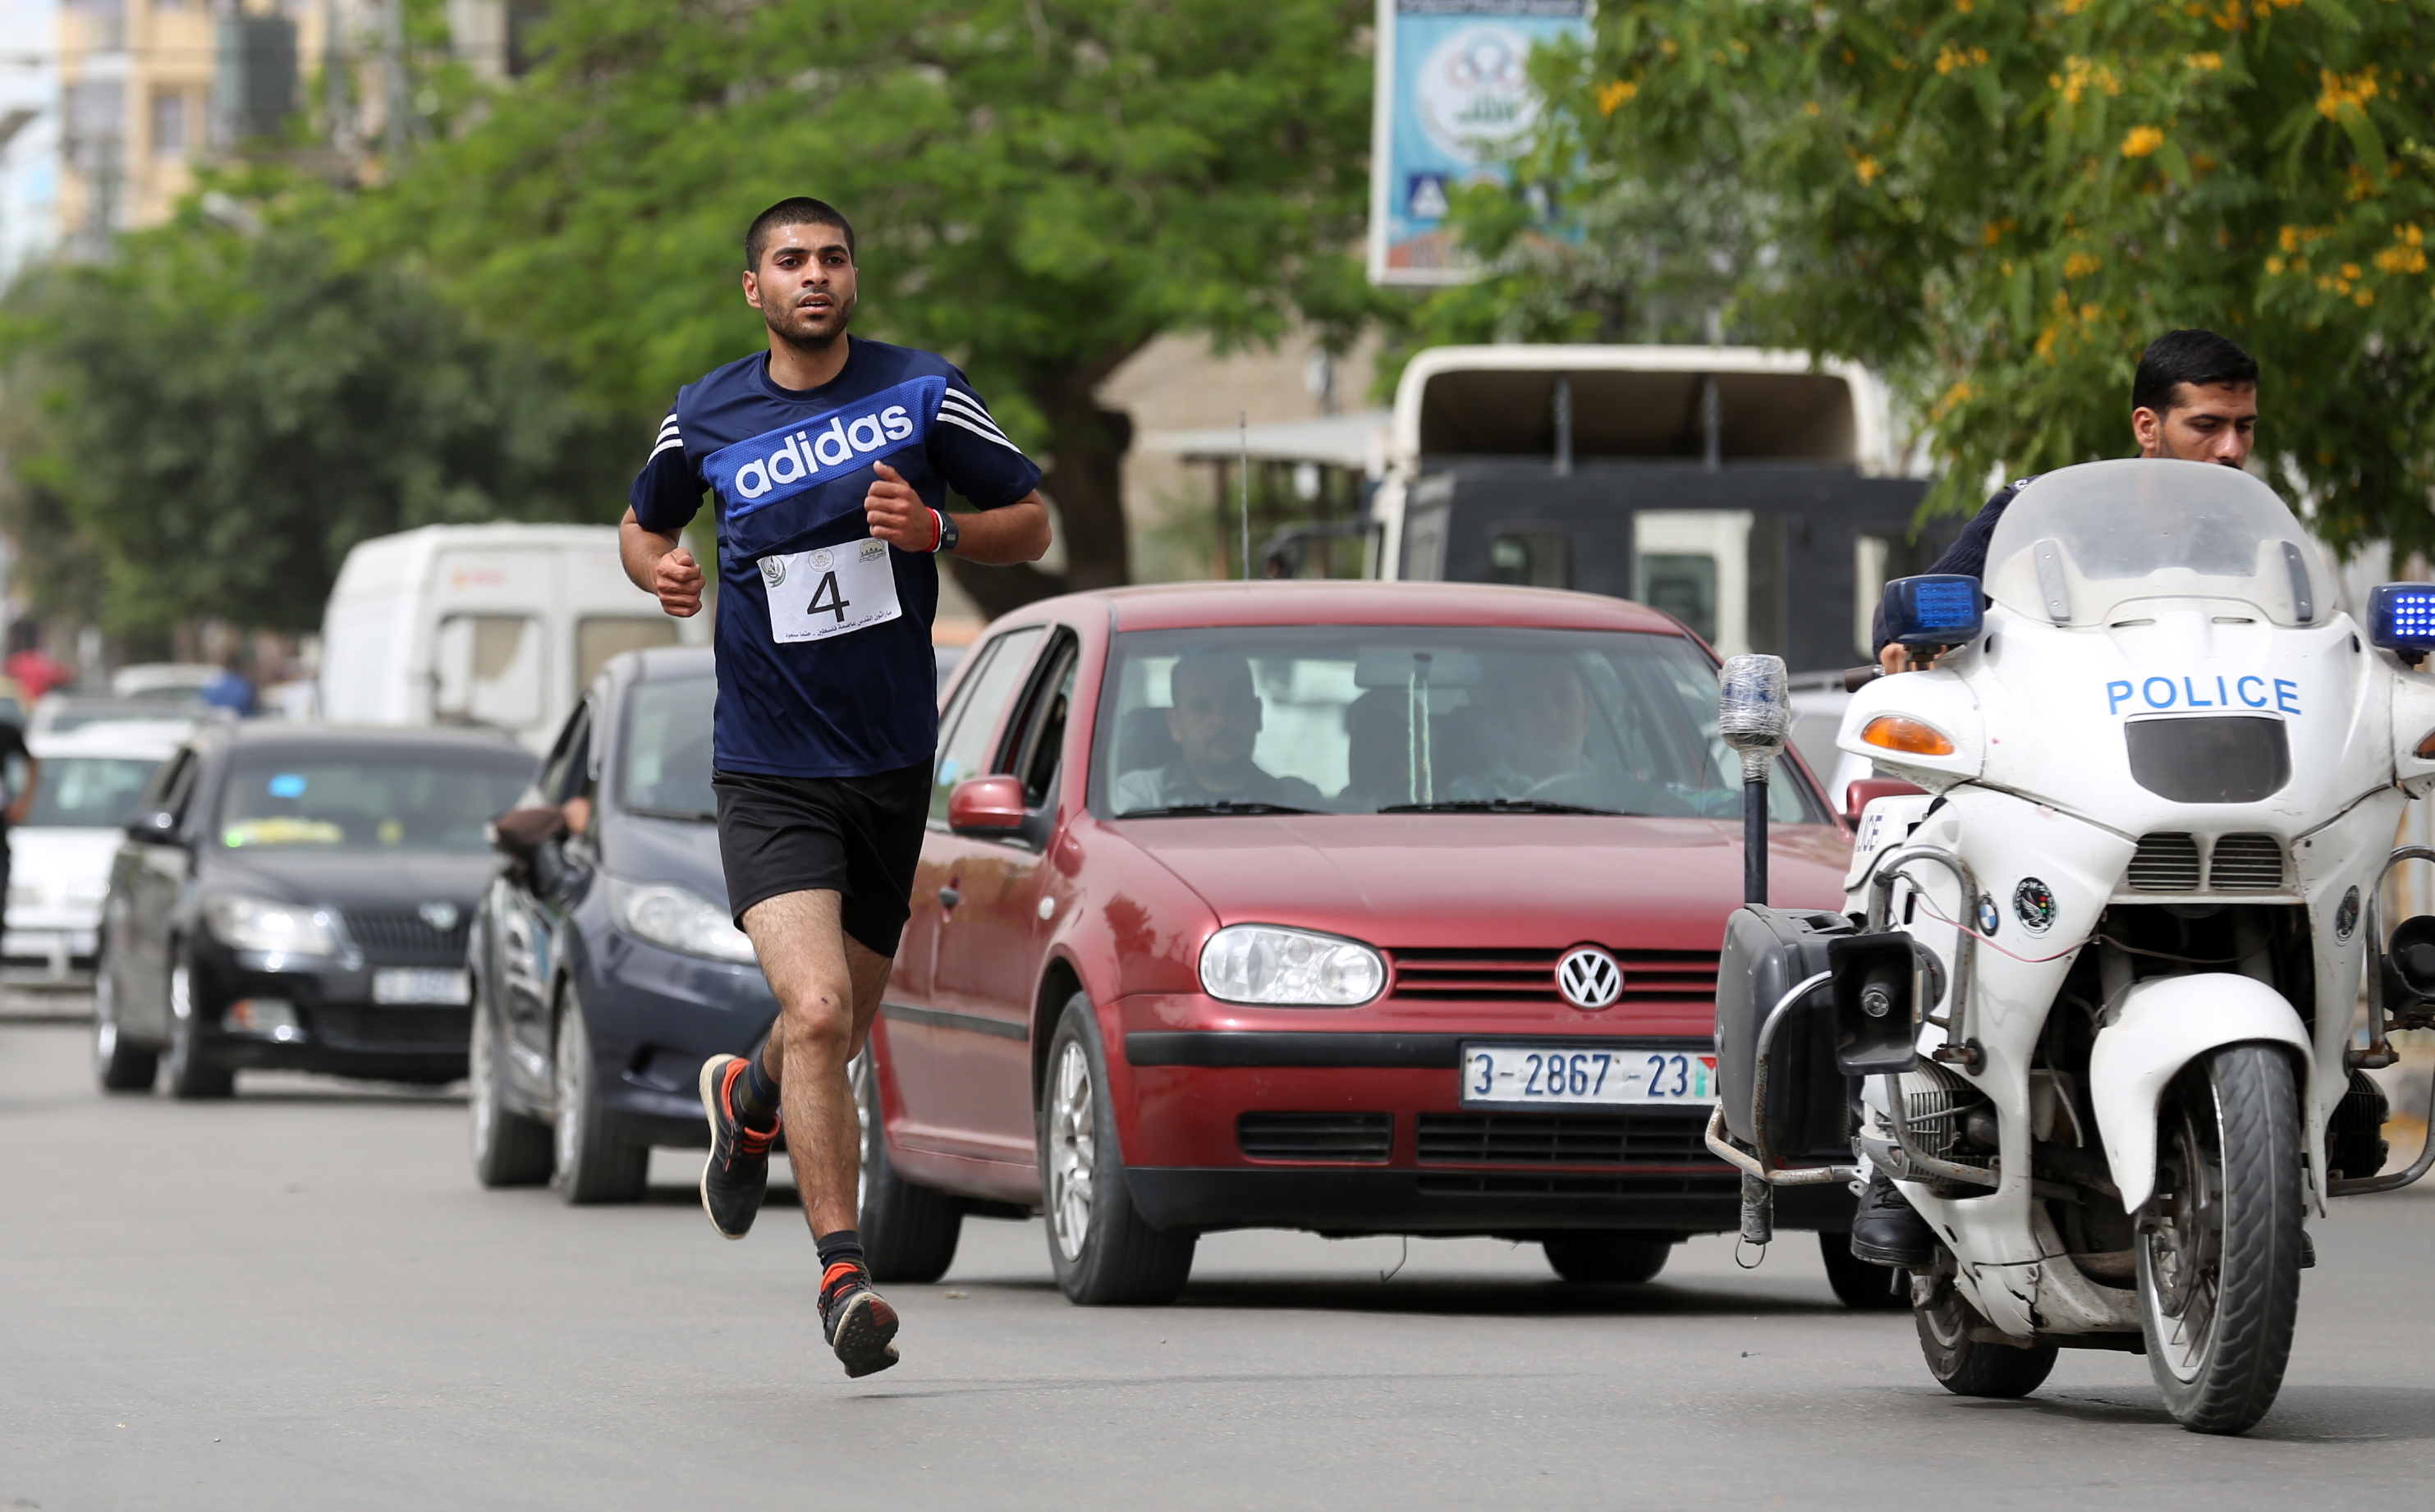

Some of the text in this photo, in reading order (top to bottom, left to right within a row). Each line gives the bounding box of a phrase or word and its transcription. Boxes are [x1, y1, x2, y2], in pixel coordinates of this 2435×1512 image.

[735, 405, 913, 498] adidas
[807, 570, 850, 622] 4
[839, 621, 857, 630] عاصمة
[858, 616, 874, 626] القدس
[875, 610, 892, 621] ماراثون
[818, 625, 837, 636] فلسطين
[2107, 675, 2302, 715] POLICE
[1856, 814, 1883, 852] LICE
